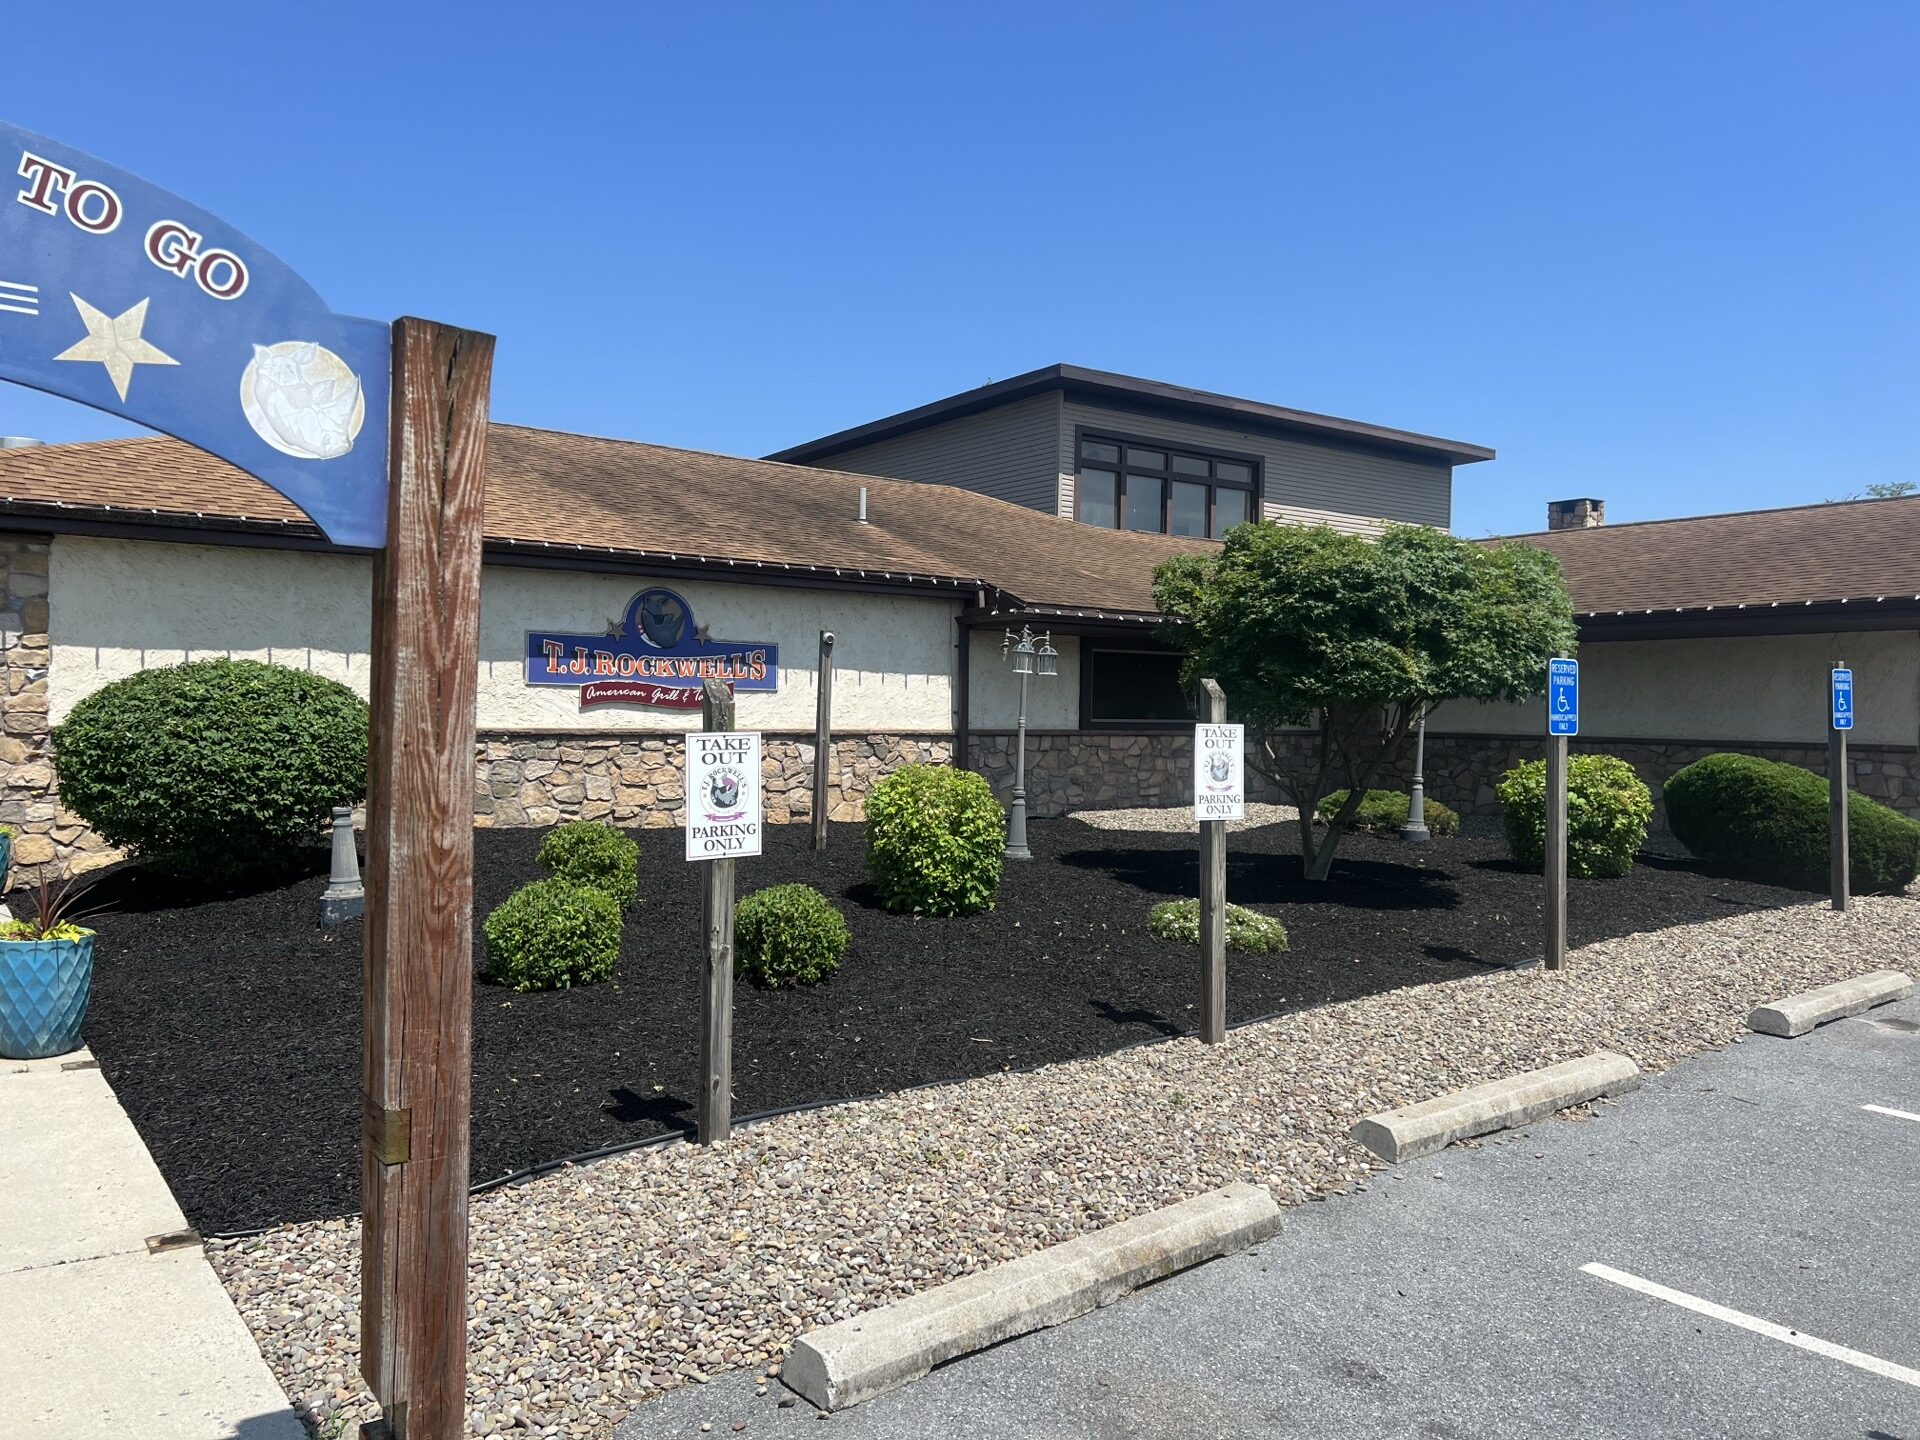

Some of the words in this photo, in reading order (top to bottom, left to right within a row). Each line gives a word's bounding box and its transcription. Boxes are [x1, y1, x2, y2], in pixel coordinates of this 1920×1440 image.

[17, 151, 123, 235] TO
[144, 219, 249, 300] GO
[593, 649, 767, 681] ROCKWELL'S
[1551, 663, 1576, 675] RESERVED
[1552, 675, 1575, 686] PARKING
[586, 686, 647, 699] American
[651, 687, 679, 703] Grill
[682, 689, 690, 703] &
[1551, 713, 1576, 722] HANDICAPPED
[1558, 722, 1569, 731] ONLY
[1202, 728, 1237, 739] TAKE
[696, 738, 751, 751] TAKE
[1204, 738, 1235, 749] OUT
[701, 751, 747, 765] OUT
[1198, 794, 1241, 805] PARKING
[1206, 804, 1233, 815] ONLY
[692, 823, 757, 839] PARKING
[704, 837, 746, 851] ONLY
